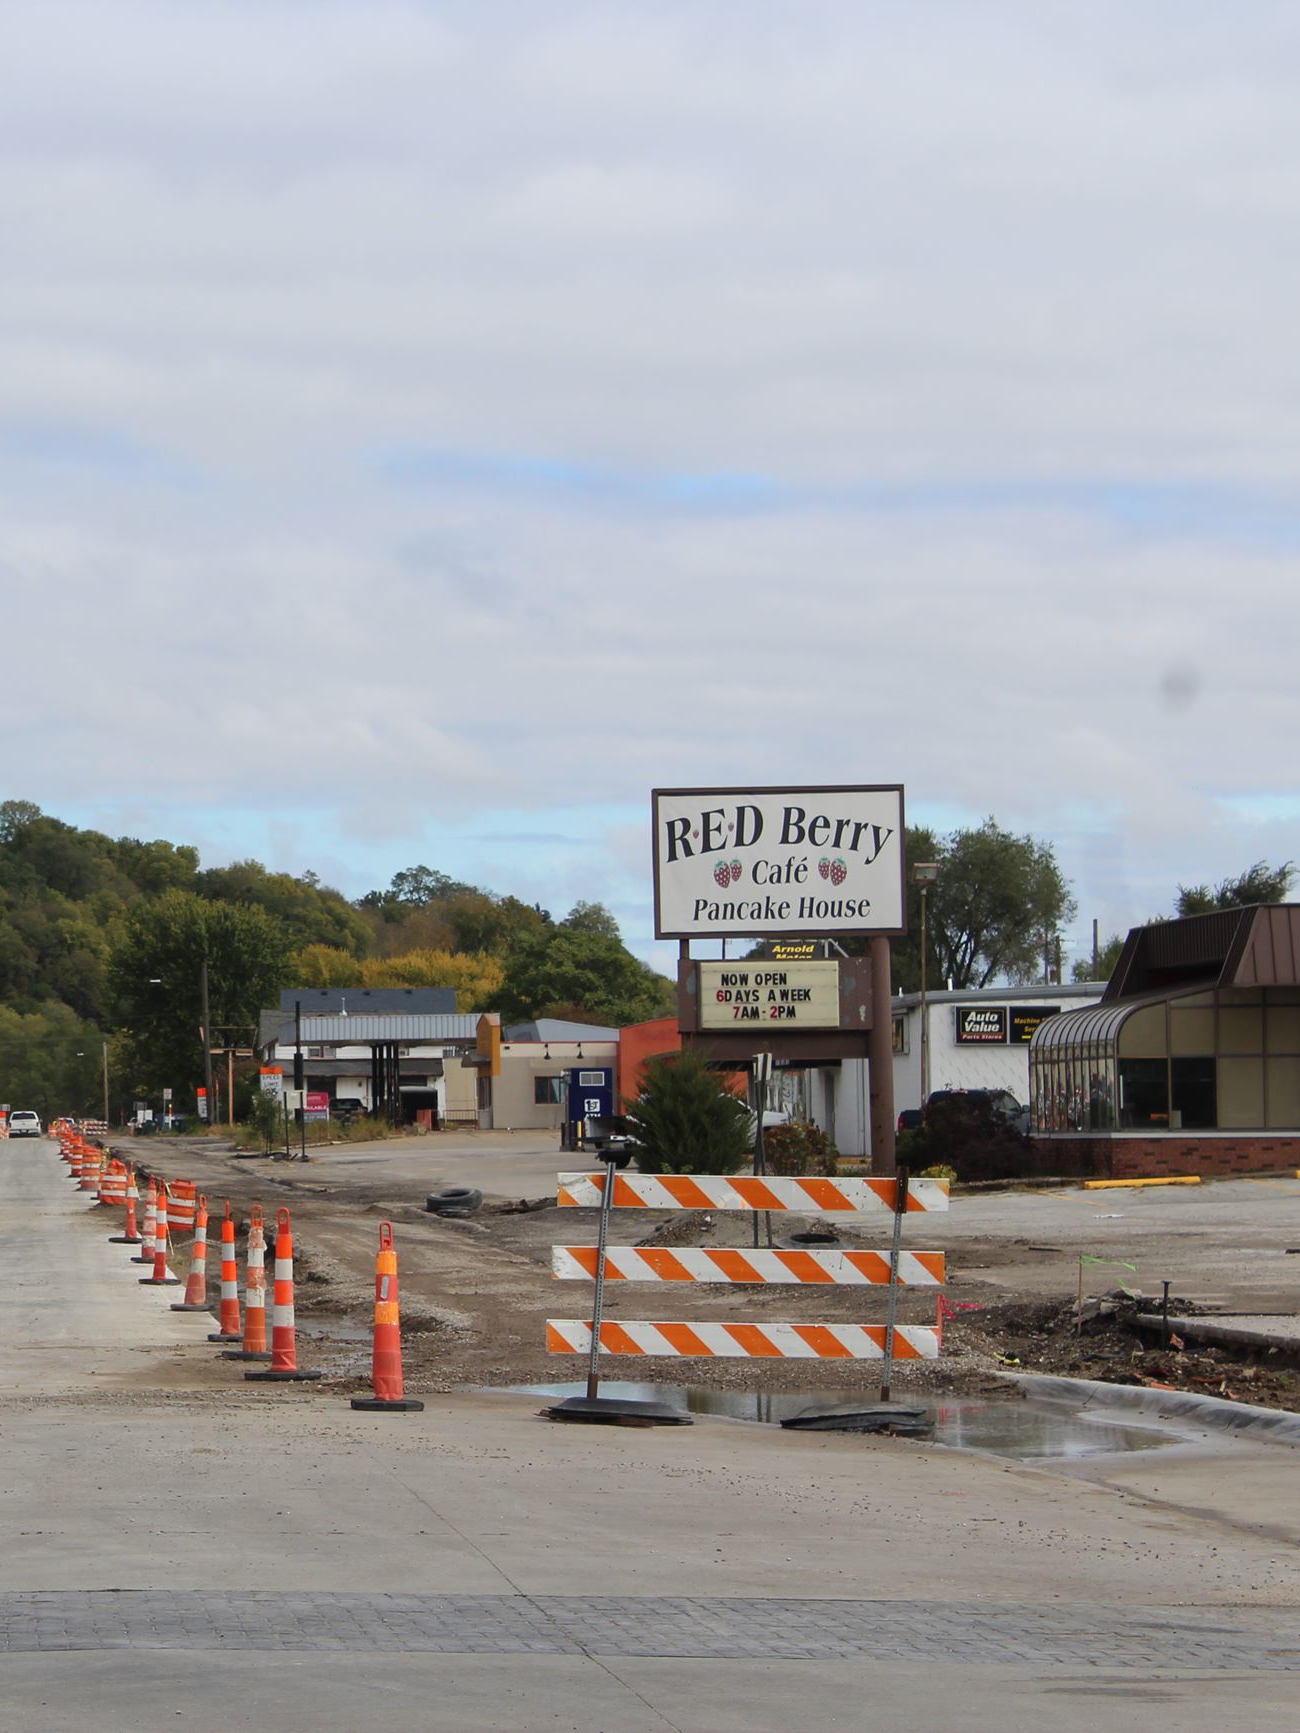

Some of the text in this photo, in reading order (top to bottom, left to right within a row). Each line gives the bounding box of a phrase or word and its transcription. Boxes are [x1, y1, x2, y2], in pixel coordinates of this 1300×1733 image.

[779, 806, 894, 865] Berry
[752, 856, 808, 885] Café
[693, 896, 871, 921] Pancake House
[771, 945, 815, 953] Arnold
[721, 972, 787, 986] NOW OPEN
[780, 988, 811, 1002] WEEK
[770, 1005, 796, 1019] 2PM
[966, 1011, 999, 1022] Auto
[964, 1022, 1000, 1032] Value
